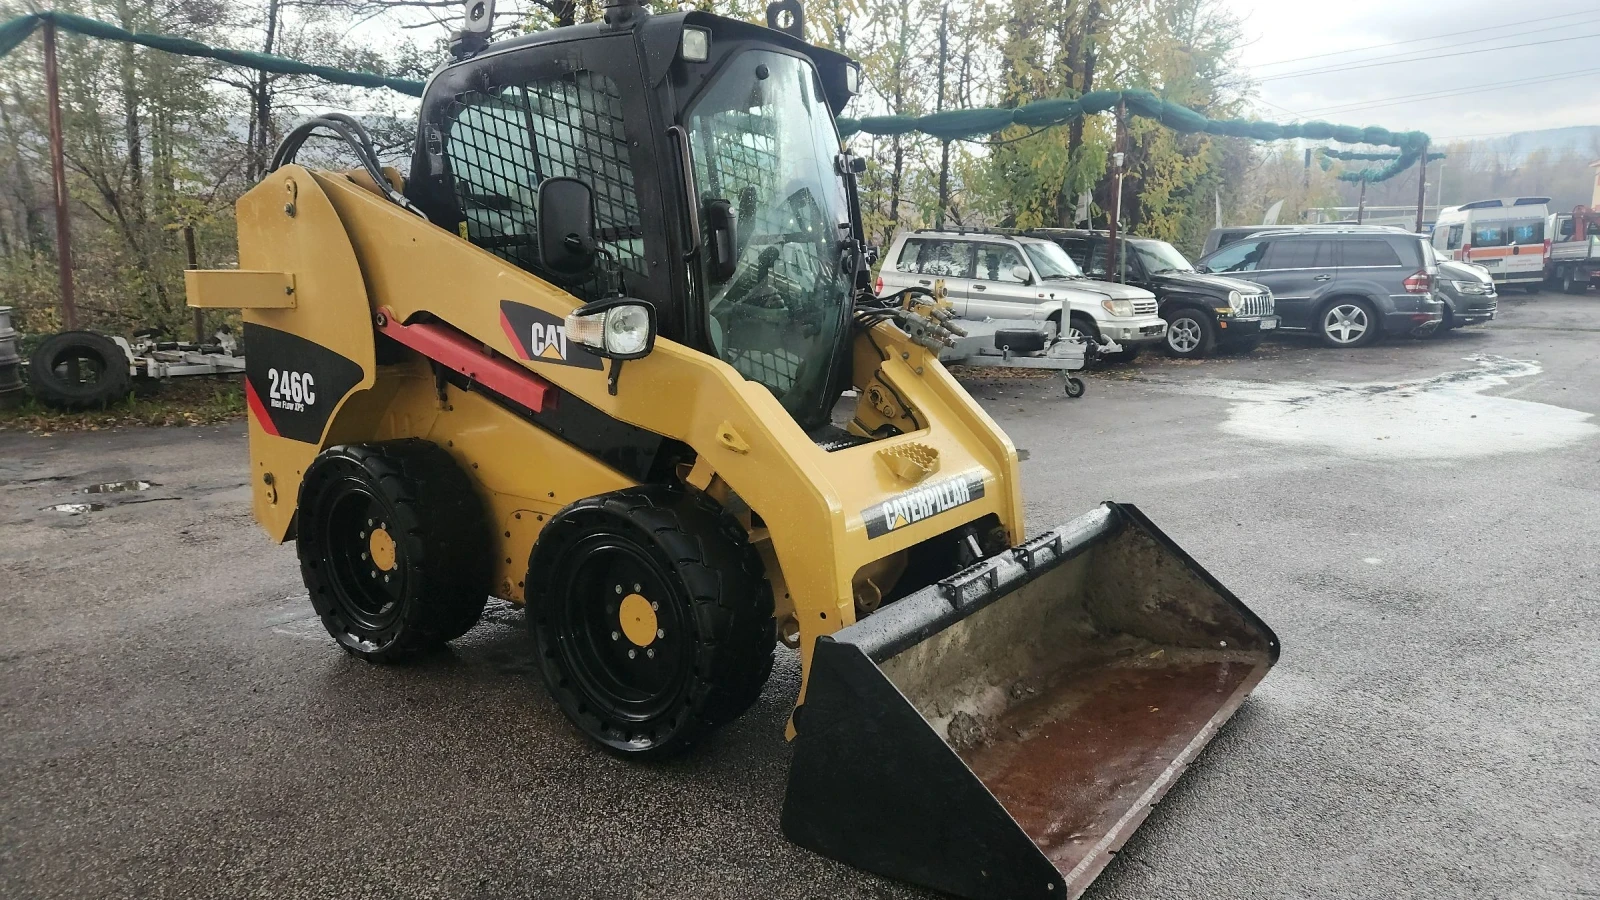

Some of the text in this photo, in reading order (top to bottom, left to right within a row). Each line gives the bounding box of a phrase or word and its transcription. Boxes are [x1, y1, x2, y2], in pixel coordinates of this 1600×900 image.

[531, 322, 567, 360] CAT
[268, 368, 315, 405] 246C
[294, 402, 304, 412] XPS
[882, 477, 970, 531] CATERPILLAR
